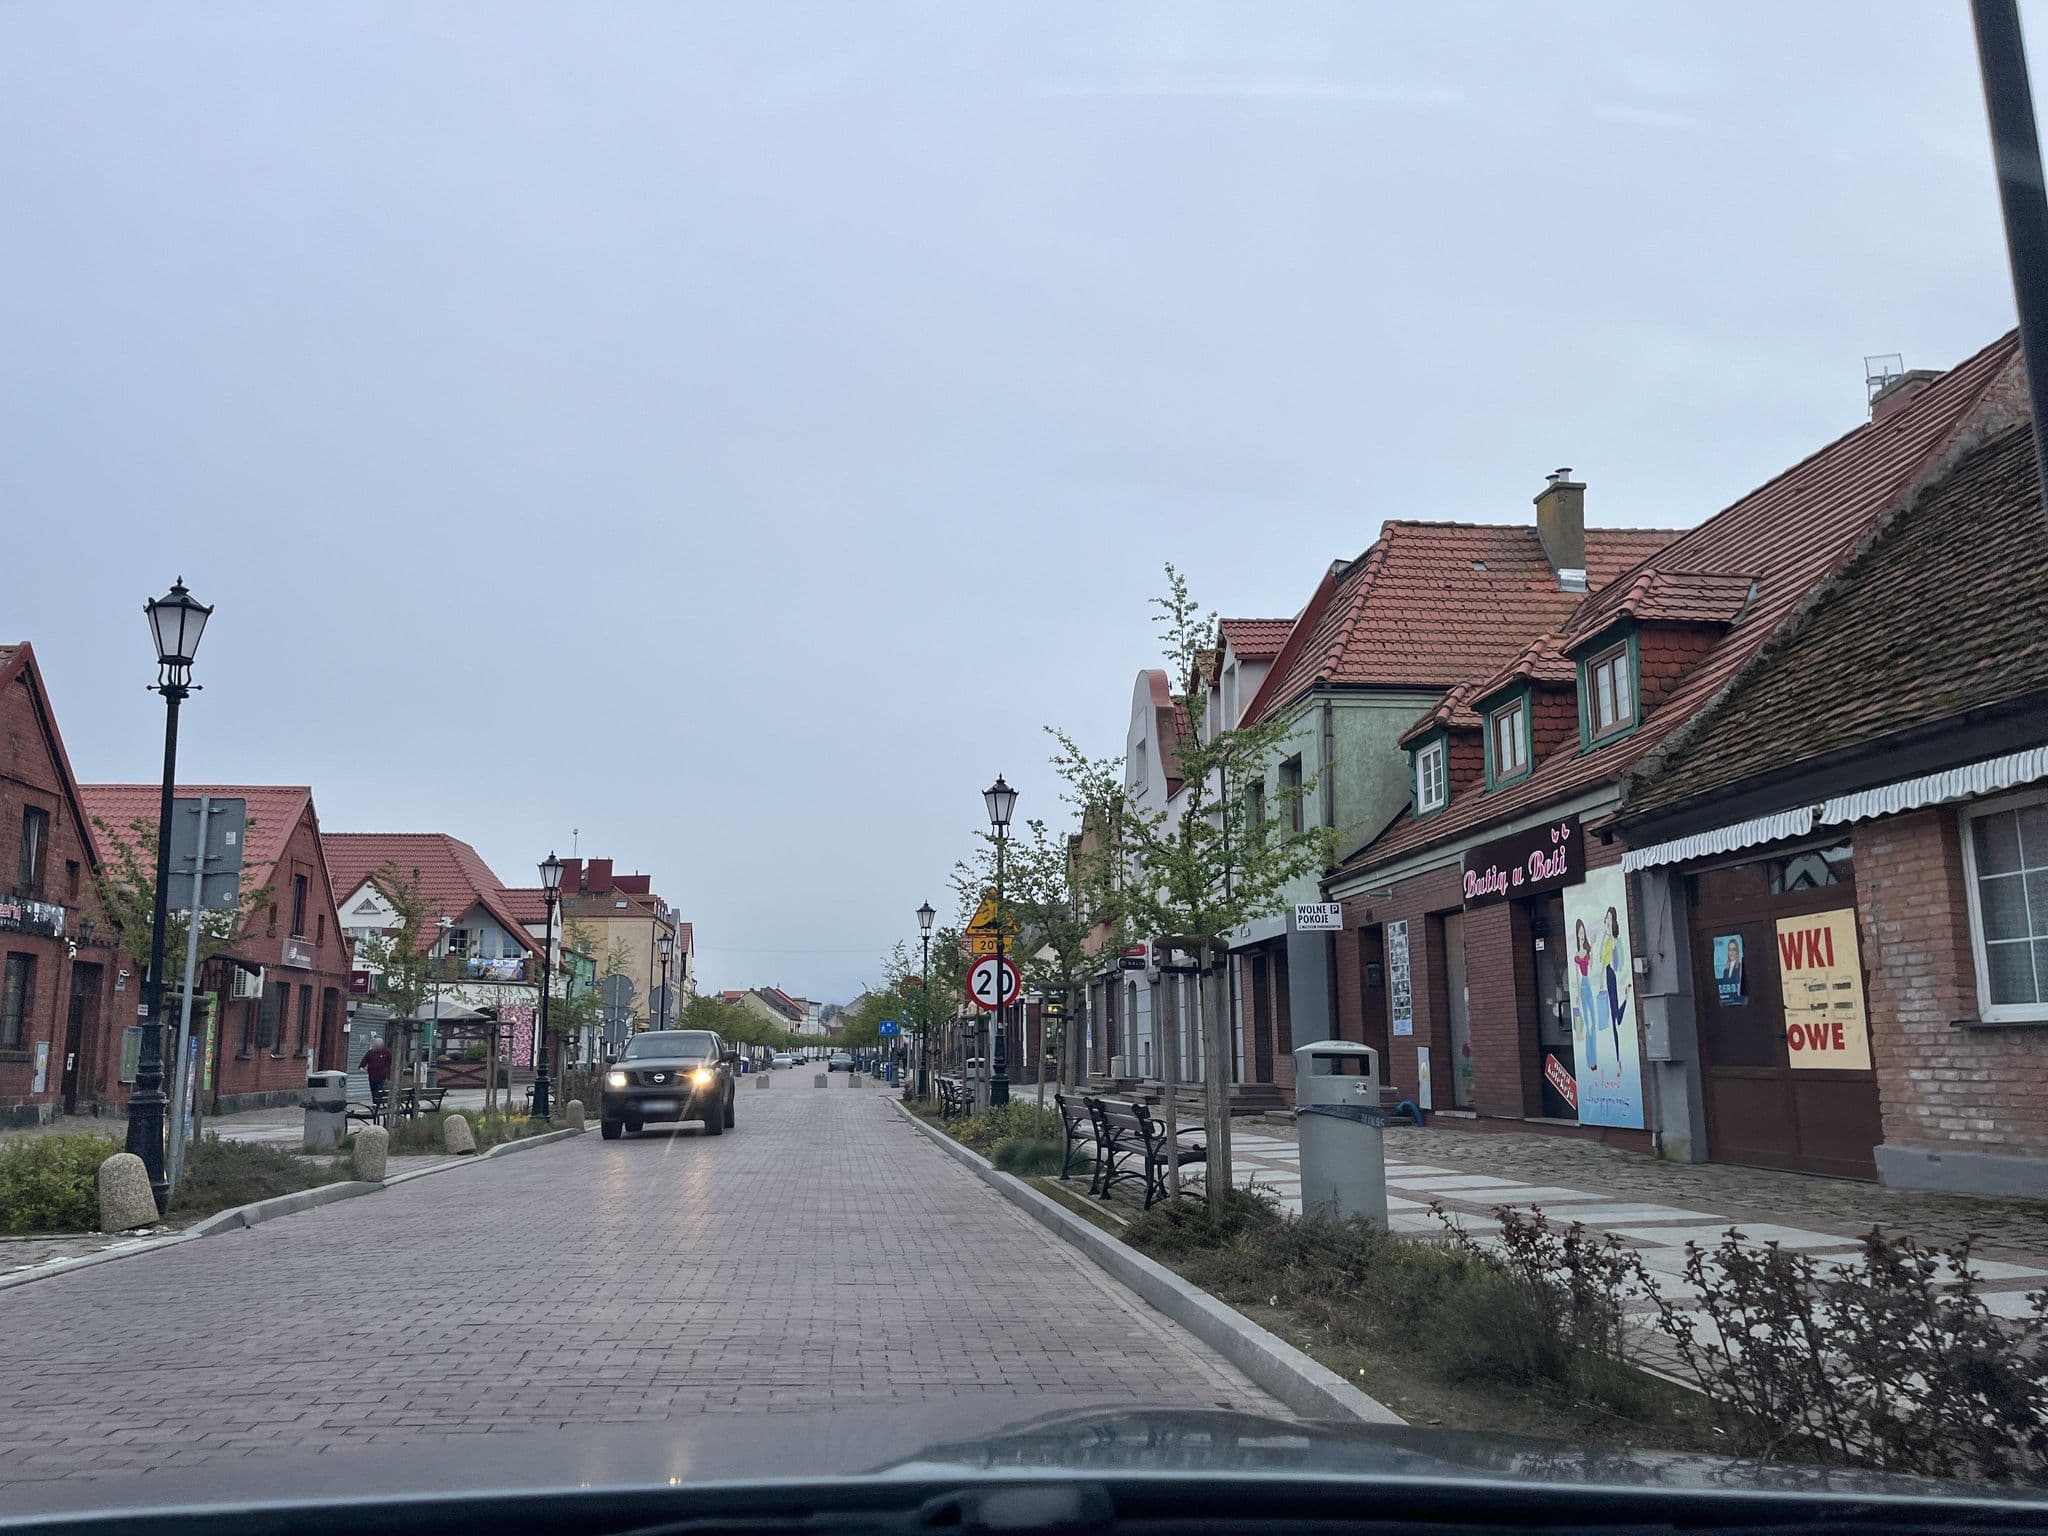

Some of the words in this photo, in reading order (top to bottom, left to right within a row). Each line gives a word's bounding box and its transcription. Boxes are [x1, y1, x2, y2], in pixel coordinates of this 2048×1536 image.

[1463, 865, 1508, 899] Butiq
[1512, 866, 1524, 886] u
[1528, 845, 1567, 882] Beti
[1298, 905, 1327, 914] WOLNE
[1298, 914, 1329, 924] POKOJE
[980, 940, 994, 950] 20
[1779, 927, 1834, 971] WKI
[1787, 1022, 1846, 1051] OWE
